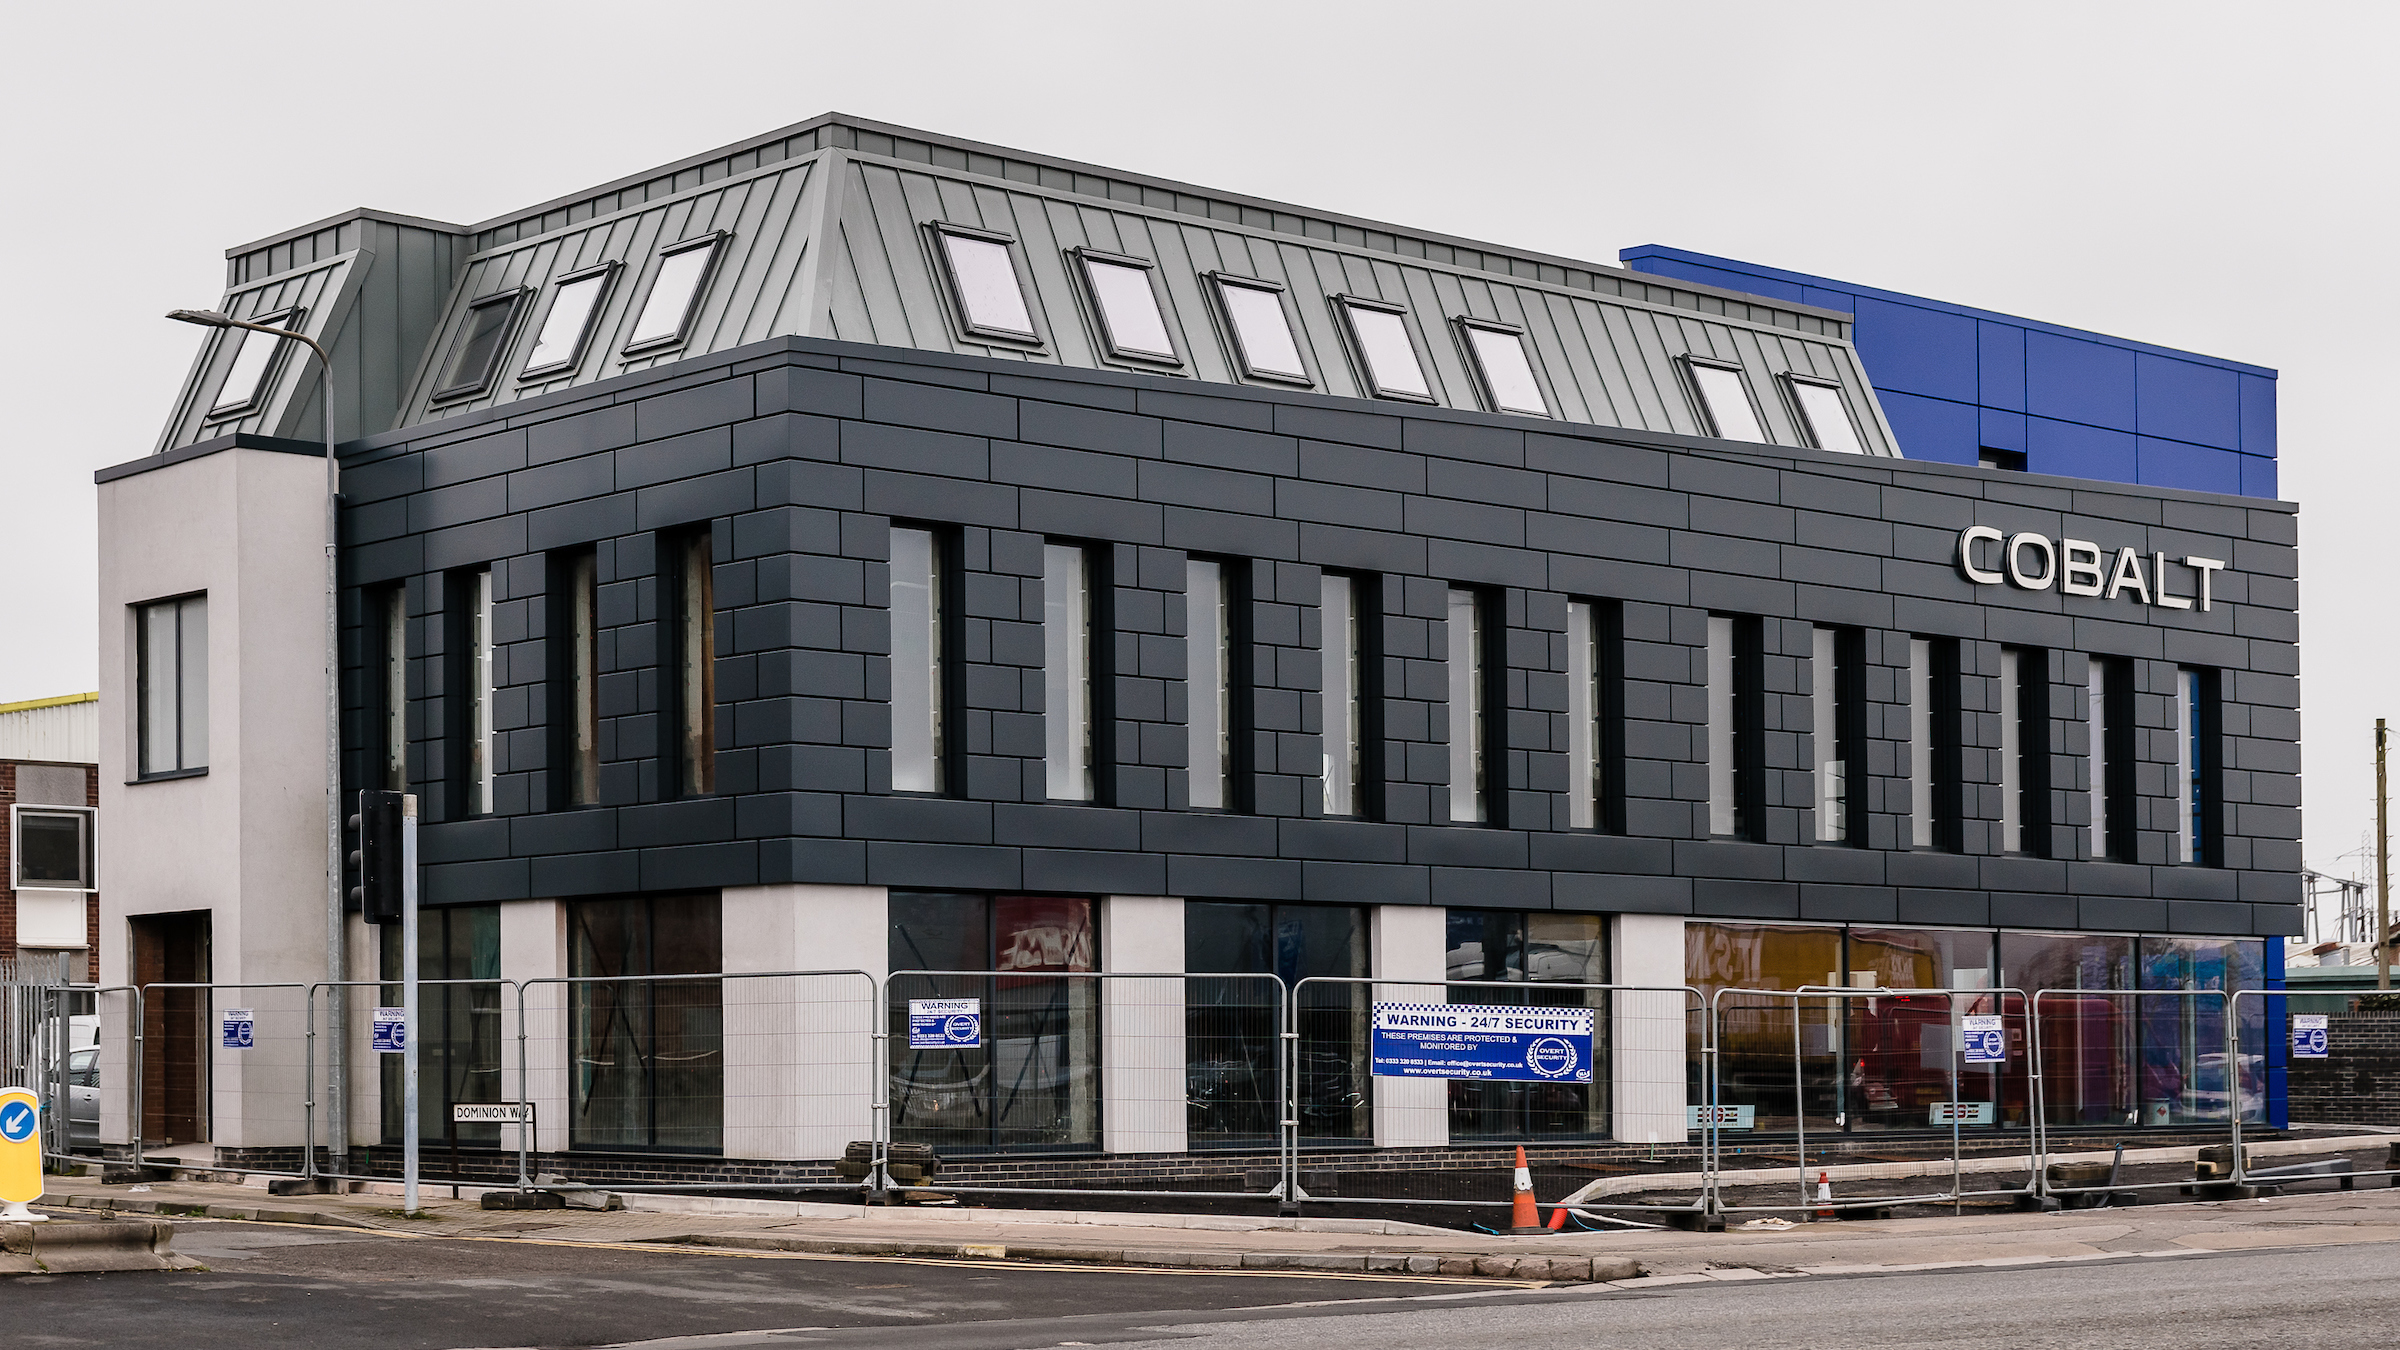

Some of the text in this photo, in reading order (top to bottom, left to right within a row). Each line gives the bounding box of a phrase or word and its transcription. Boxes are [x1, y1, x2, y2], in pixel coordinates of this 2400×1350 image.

[1958, 525, 2226, 612] COBALT
[1387, 1014, 1457, 1027] WARNING
[1470, 1017, 1500, 1028] 24/7
[1505, 1018, 1578, 1031] SECURITY
[1381, 1032, 1406, 1040] THESE
[1407, 1033, 1446, 1041] PREMISES
[1446, 1034, 1463, 1042] ARE
[1464, 1034, 1511, 1043] PROTECTED
[1420, 1042, 1478, 1051] MONITORED BY
[1427, 1059, 1446, 1067] Email:
[1403, 1067, 1492, 1077] www.overtsecurity.co.uk
[457, 1107, 529, 1119] DOMINION WY
